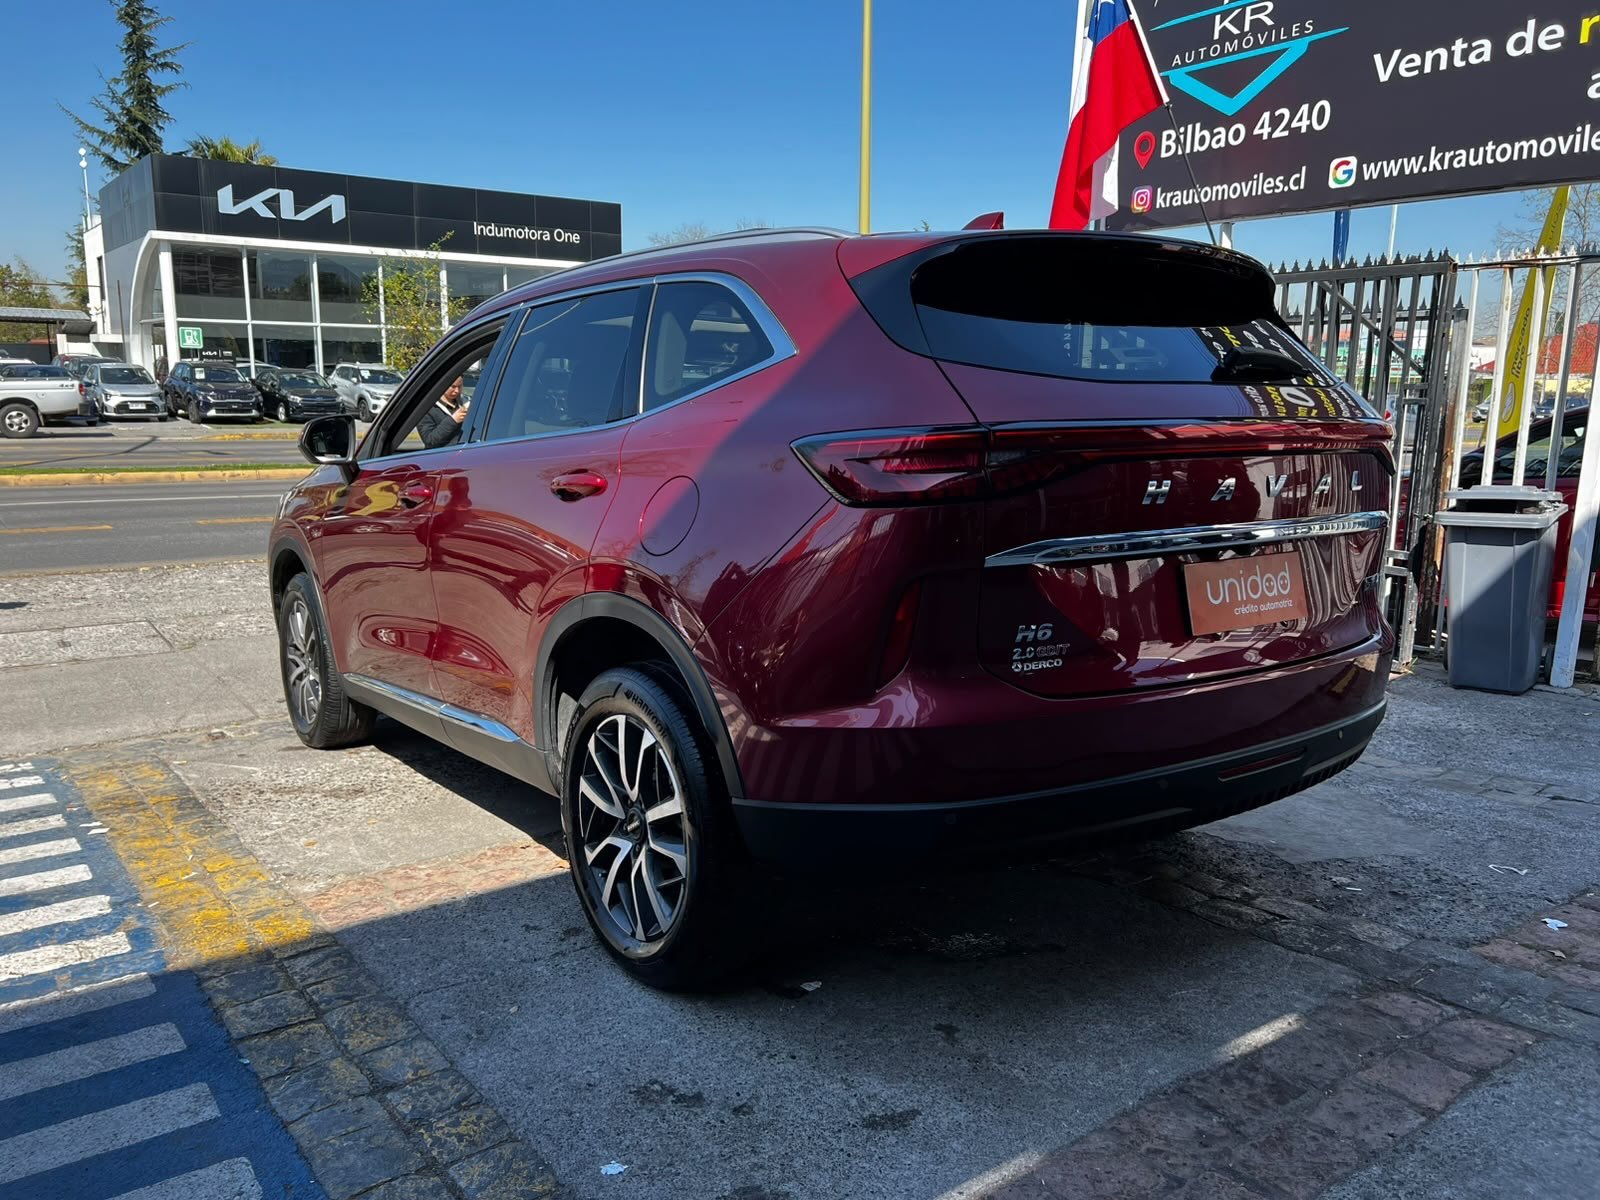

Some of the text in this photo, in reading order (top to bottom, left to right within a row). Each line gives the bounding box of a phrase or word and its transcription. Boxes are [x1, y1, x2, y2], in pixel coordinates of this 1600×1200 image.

[1213, 1, 1275, 41] KR
[1171, 20, 1315, 68] AUTOMÓVILES
[1373, 37, 1492, 83] Venta
[1505, 18, 1566, 58] de
[1160, 99, 1332, 159] Bilbao 4240
[216, 183, 346, 224] KIA
[1155, 166, 1307, 209] krautomoviles.cl
[473, 221, 581, 244] Indumotora One
[1510, 306, 1531, 375] mercado
[1514, 345, 1526, 378] libre
[1141, 471, 1363, 505] HAVAL
[1206, 561, 1291, 606] unidad
[1233, 599, 1294, 616] crédito automotriz
[1014, 622, 1054, 643] H6
[1012, 646, 1035, 660] 2.0
[1023, 658, 1063, 671] DERCO
